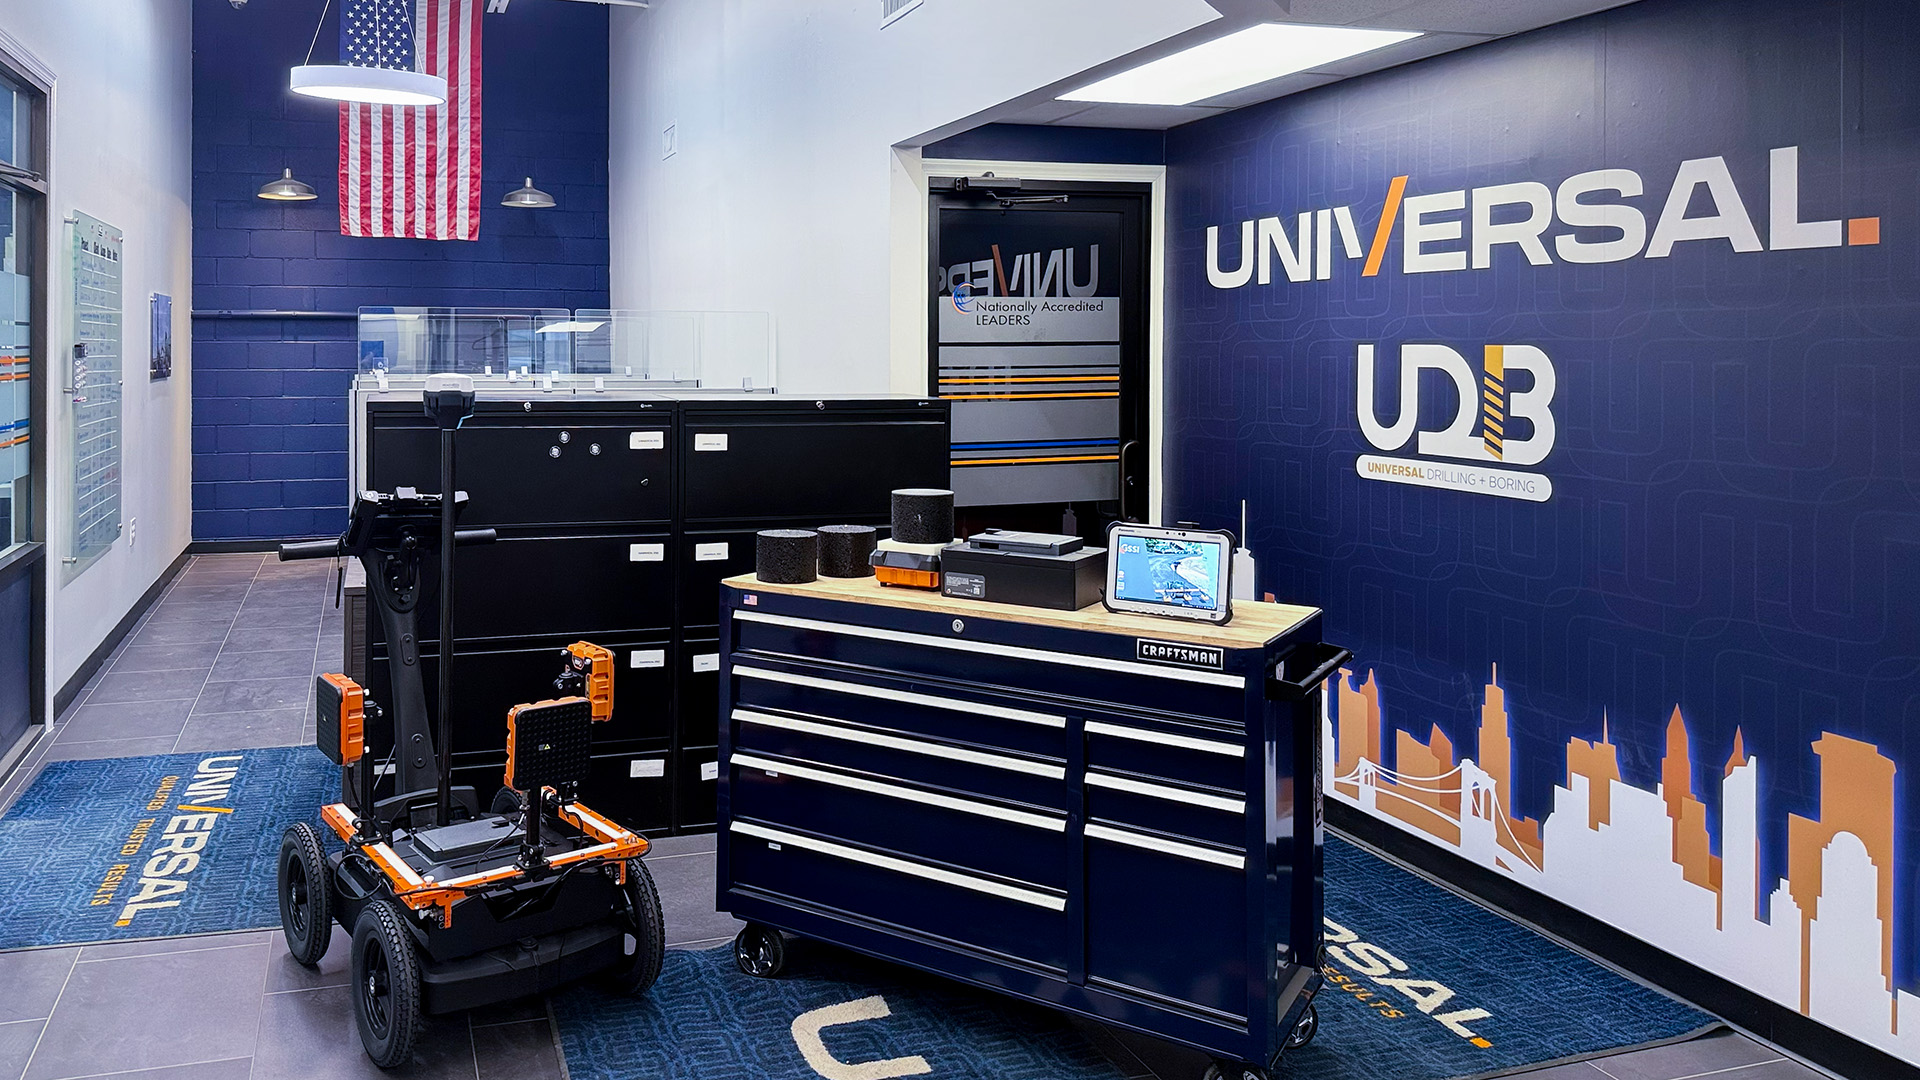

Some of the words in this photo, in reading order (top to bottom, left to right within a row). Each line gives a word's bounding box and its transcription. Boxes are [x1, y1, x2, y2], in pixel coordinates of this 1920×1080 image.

[976, 301, 1037, 314] Nationally
[1041, 301, 1104, 312] Accredited
[976, 315, 1031, 326] LEADERS
[1367, 461, 1425, 479] UNIVERSAL
[1427, 468, 1476, 486] DRILLING
[1489, 475, 1535, 493] BORING
[1120, 543, 1140, 554] GSSI
[1142, 644, 1218, 665] CRAFTSMAN
[146, 775, 179, 811] QUALIFIED
[120, 817, 156, 856] TRUSTED
[91, 863, 130, 906] RESULTS
